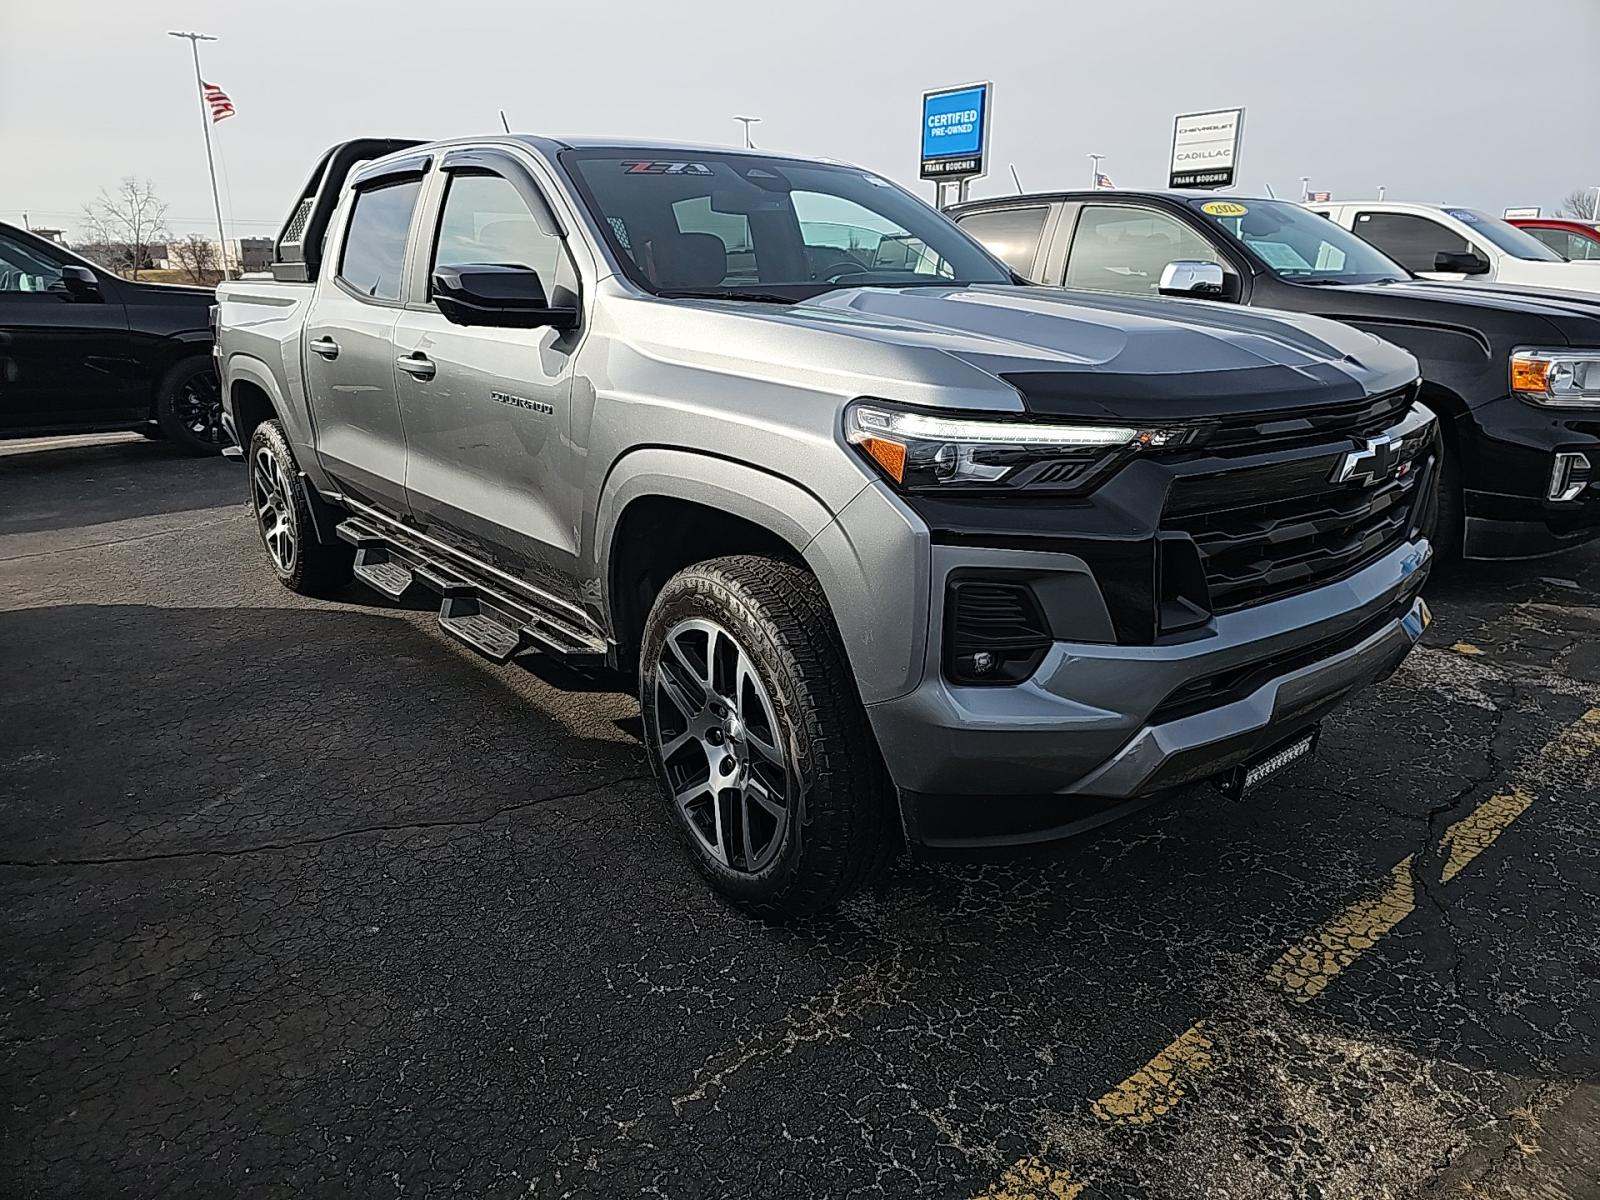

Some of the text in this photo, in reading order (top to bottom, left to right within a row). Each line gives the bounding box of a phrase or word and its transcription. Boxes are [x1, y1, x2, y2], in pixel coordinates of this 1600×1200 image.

[927, 109, 978, 128] CERTIFIED
[931, 123, 974, 137] PRE-OWNED
[1178, 122, 1234, 134] CHEVROLET
[1176, 149, 1231, 161] CADILLAC
[924, 163, 944, 172] FRANK
[1173, 175, 1195, 185] FRANK
[1210, 203, 1243, 215] 2021
[490, 390, 554, 414] COLORADO
